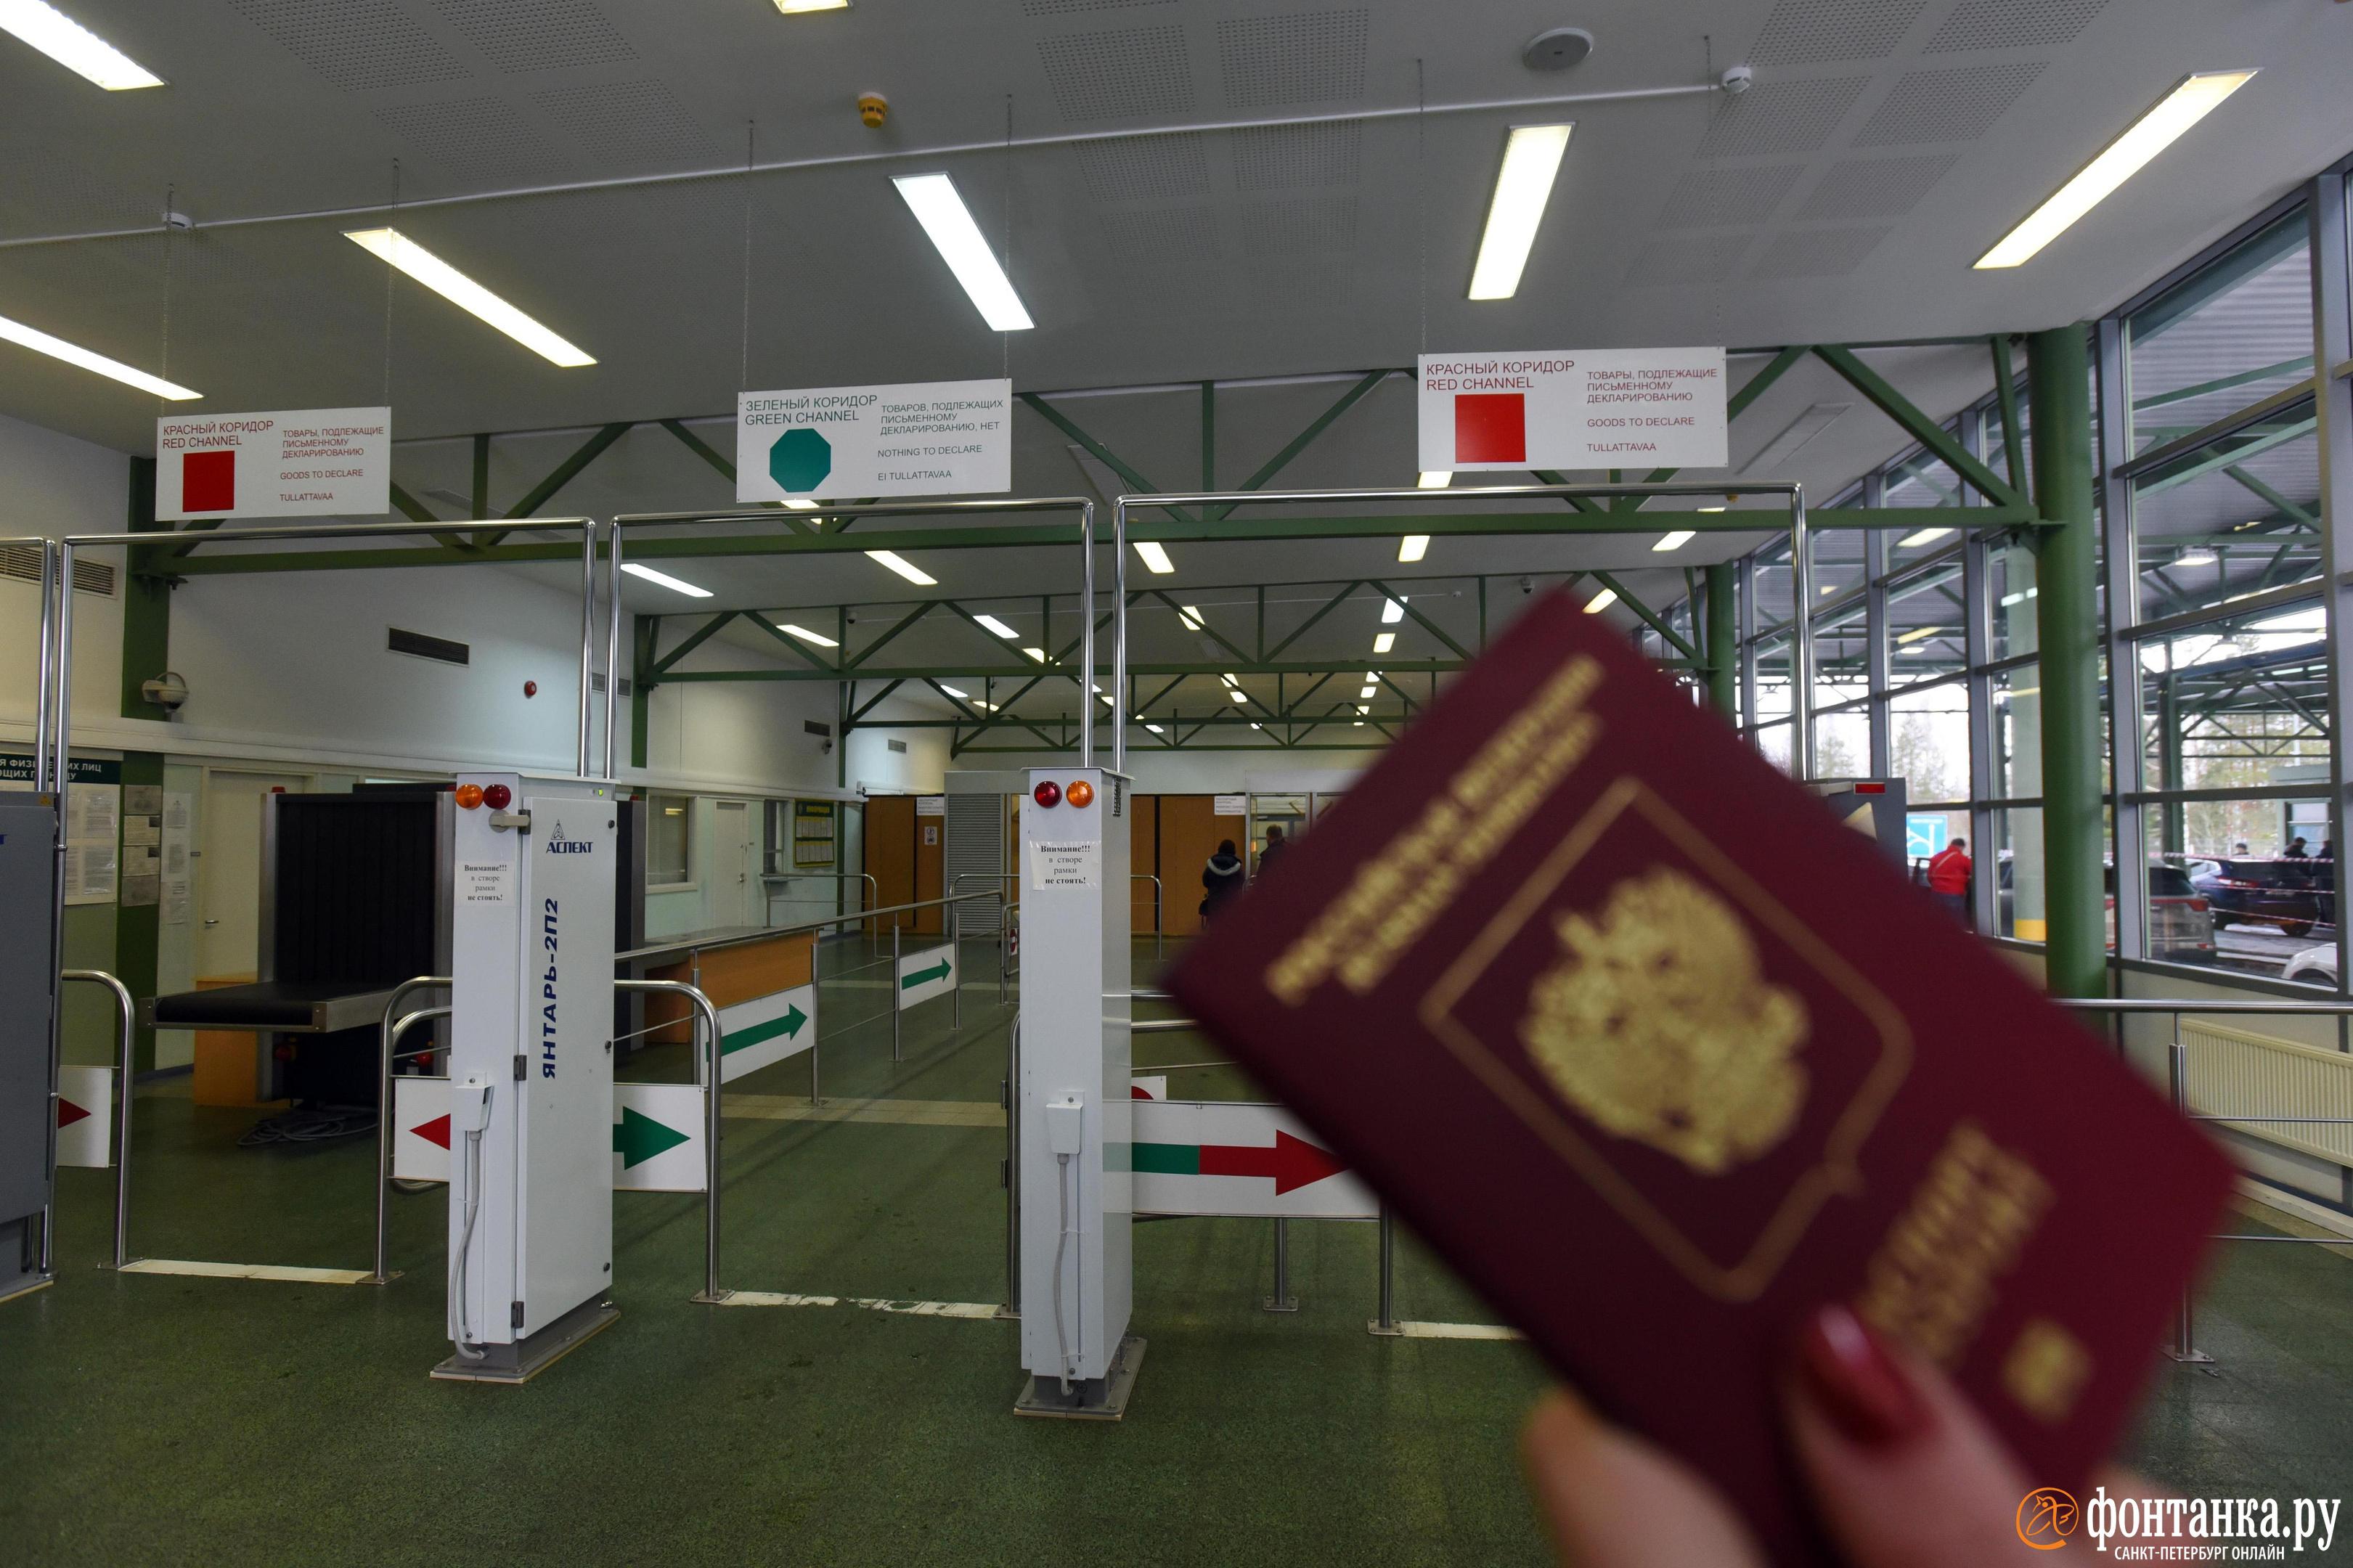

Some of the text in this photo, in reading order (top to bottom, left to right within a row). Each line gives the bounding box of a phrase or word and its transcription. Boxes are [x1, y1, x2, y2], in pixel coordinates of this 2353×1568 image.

[1426, 360, 1575, 375] КРАСНЫЙ КОРИДОР
[1587, 369, 1718, 380] ТОВАРЫ, ПОДЛЕЖАЩИЕ
[1426, 377, 1534, 391] RED CHANNEL
[1587, 381, 1673, 391] ПИСЬМЕННОМУ
[746, 394, 878, 411] ЗЕЛЕНЫЙ КОРИДОР
[1587, 392, 1693, 404] ДЕКЛАРИРОВАНИЮ
[881, 399, 1003, 414] ТОВАРОВ, ПОДЛЕЖАЩИХ
[745, 410, 860, 425] GREEN CHANNEL
[881, 413, 958, 424] ПИСЬМЕННОМУ
[1587, 417, 1695, 428] GOODS TO DECLARE
[163, 420, 274, 436] КРАСНЫЙ КОРИДОР
[283, 426, 384, 438] ТОВАРЫ, ПОДЛЕЖАЩИЕ
[880, 422, 999, 436] ДЕКЛАРИРОВАНИЮ, НЕТ
[163, 436, 242, 449] RED CHANNEL
[282, 438, 348, 448] ПИСЬМЕННОМУ
[1587, 443, 1657, 452] TULLATTAVAA
[282, 448, 364, 459] ДЕКЛАРИРОВАНИЮ
[878, 447, 921, 457] NOTHING
[938, 445, 982, 454] DECLARE
[280, 471, 310, 480] GOODS
[325, 469, 364, 478] DECLARE
[878, 470, 952, 481] EI TULLATTAVAA
[280, 493, 333, 502] TULLATTAVAA
[81, 763, 102, 773] ЛИЦ
[545, 841, 594, 854] АСПЕКТ
[464, 864, 507, 873] Внимание!!!
[542, 897, 558, 1079] ЯНТАРЬ-2П2
